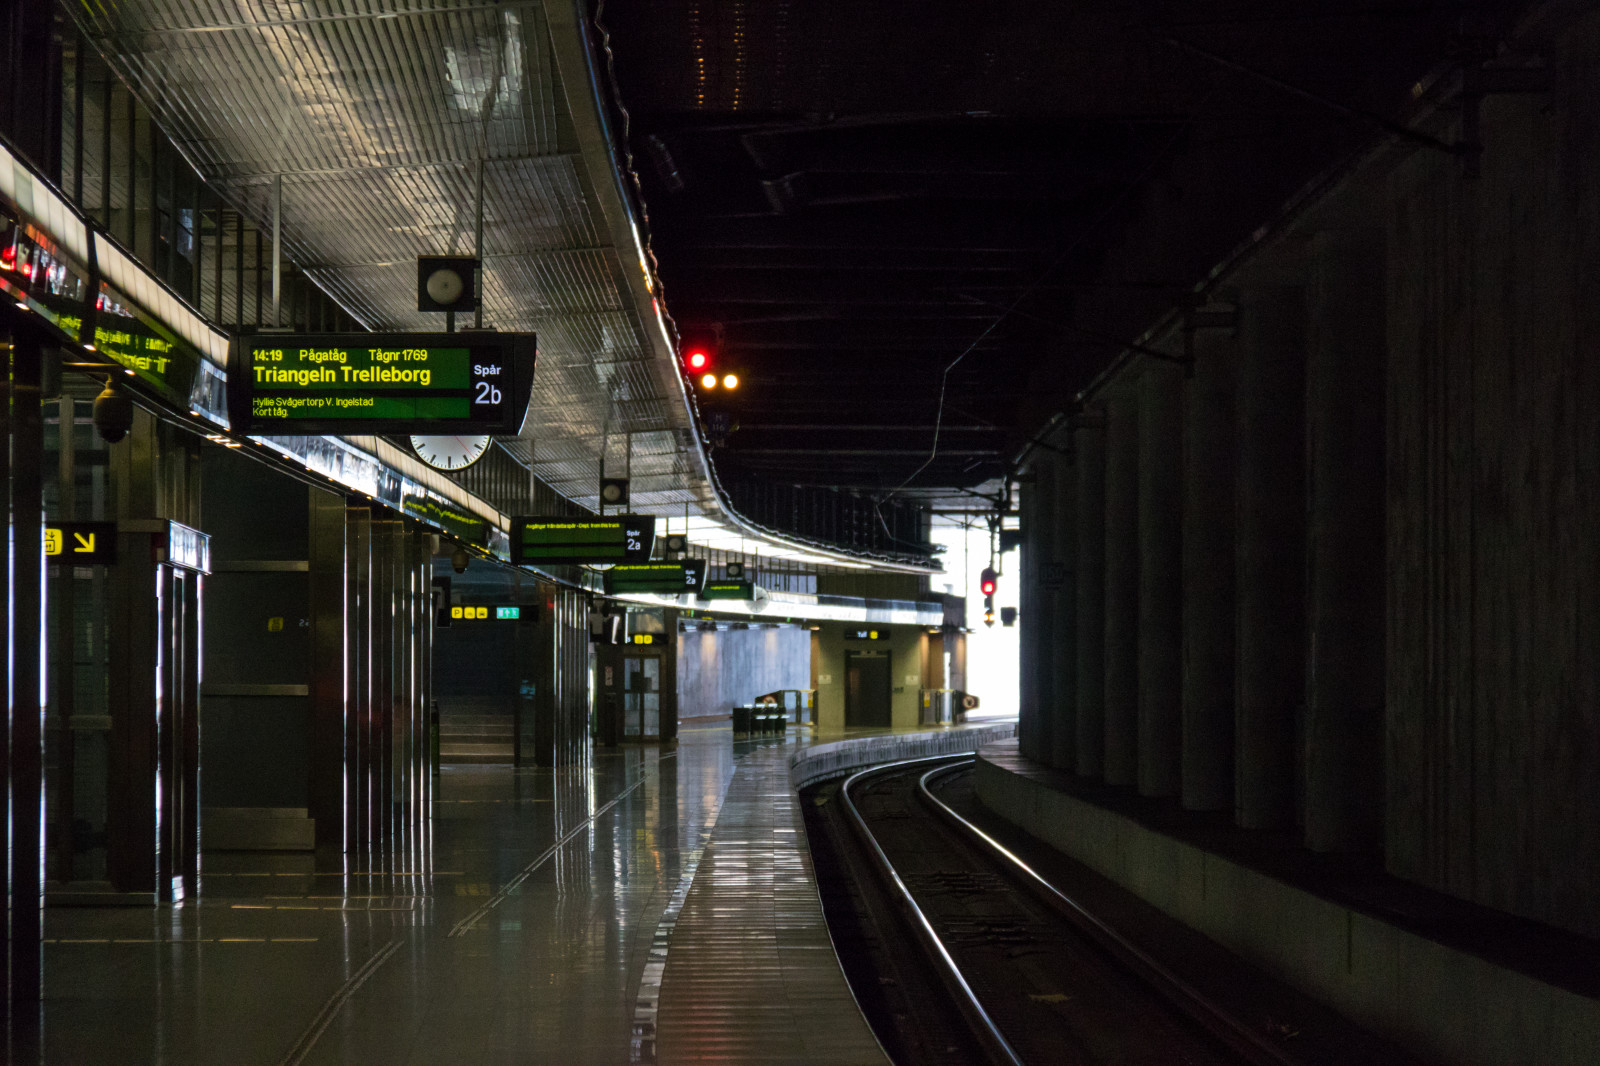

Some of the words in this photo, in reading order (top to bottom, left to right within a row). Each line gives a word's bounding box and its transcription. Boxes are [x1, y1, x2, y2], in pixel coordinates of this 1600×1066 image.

[252, 349, 283, 362] 14:19
[299, 347, 347, 364] Pågatåg
[368, 347, 400, 364] Tågnr
[401, 348, 428, 362] 1769
[253, 365, 336, 386] Triangeln
[340, 365, 431, 386] Trelleborg
[474, 363, 502, 378] Spår
[475, 382, 502, 405] 2b
[252, 397, 275, 408] Hyllie
[335, 397, 374, 408] Ingelstad
[252, 407, 272, 417] Kort
[627, 538, 641, 550] 2a
[686, 575, 697, 585] 2a
